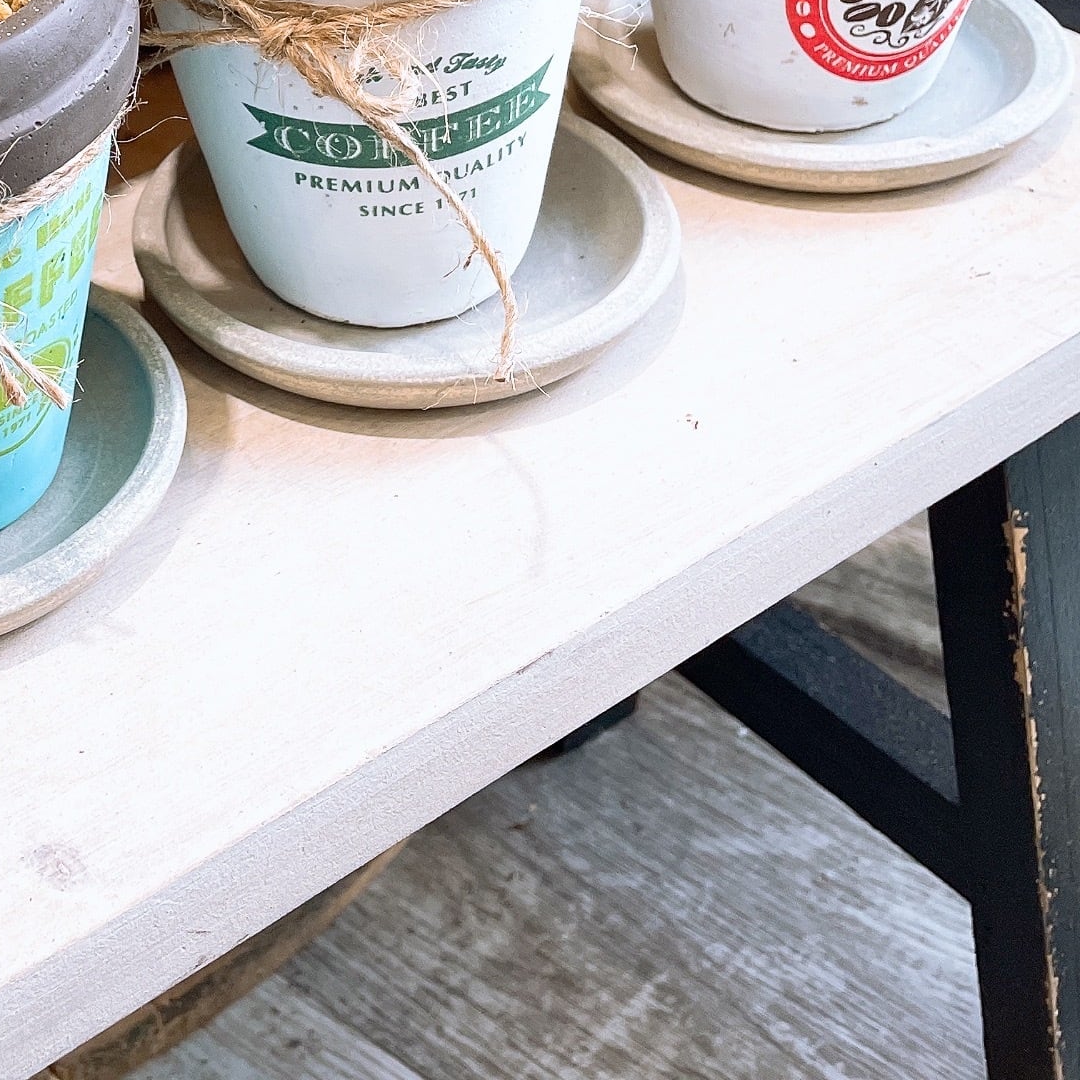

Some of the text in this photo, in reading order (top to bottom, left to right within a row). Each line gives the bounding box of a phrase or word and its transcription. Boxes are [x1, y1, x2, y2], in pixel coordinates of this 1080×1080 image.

[444, 52, 508, 76] Tasty
[814, 41, 898, 77] PREMIUM
[294, 171, 420, 195] PREMIUM
[358, 186, 477, 218] SINCE 171
